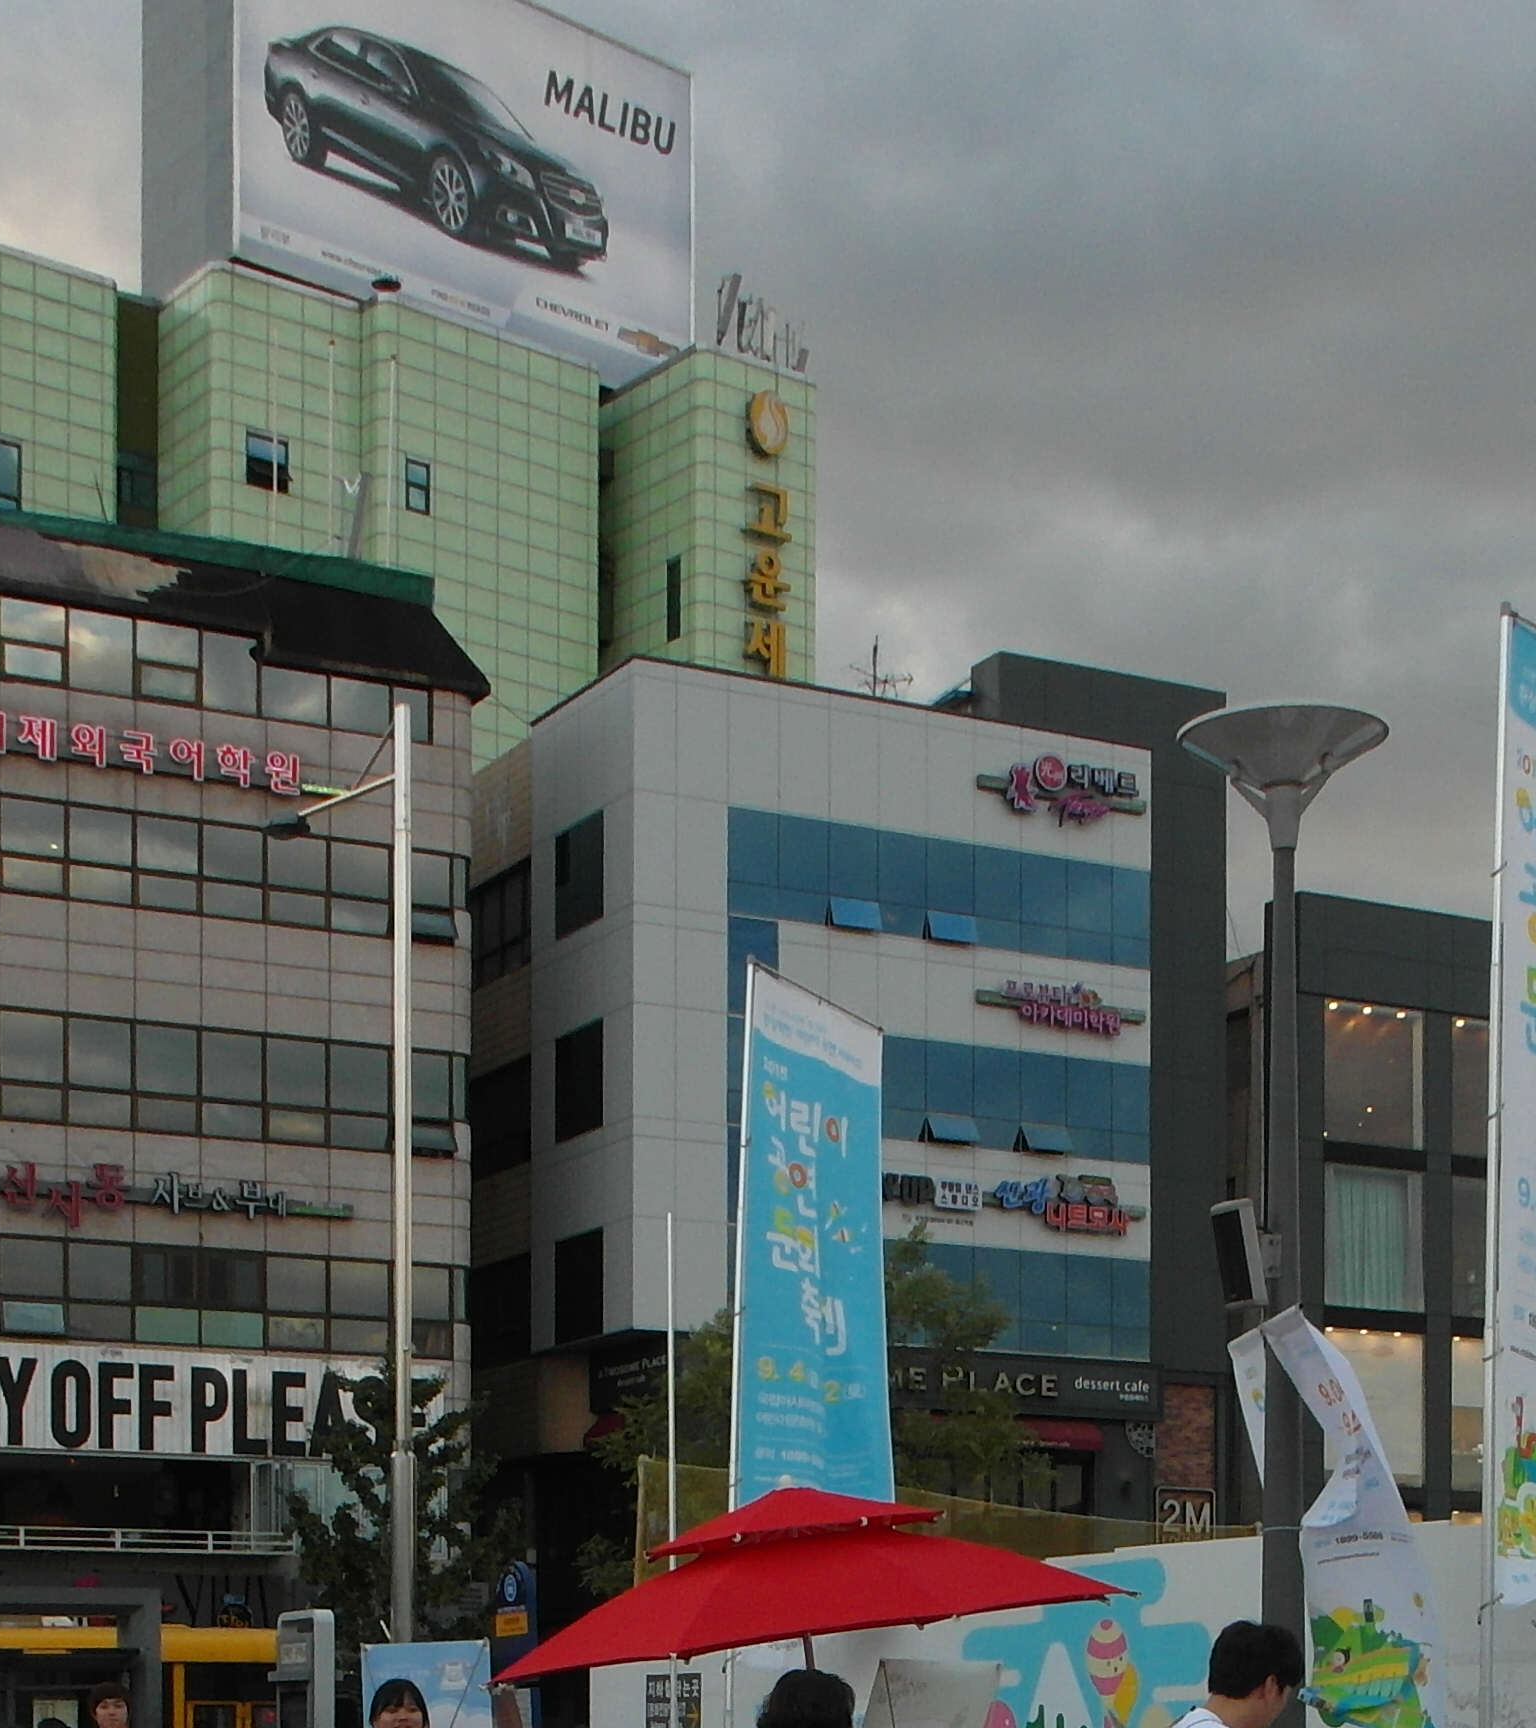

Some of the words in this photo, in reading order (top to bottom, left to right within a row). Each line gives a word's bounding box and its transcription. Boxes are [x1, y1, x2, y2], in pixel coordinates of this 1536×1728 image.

[544, 69, 676, 155] MALIBU
[535, 296, 610, 333] CHEVROLET
[2, 1162, 128, 1229] 신사동
[941, 1365, 1060, 1398] PLACE
[1074, 1375, 1121, 1392] dessert
[1125, 1379, 1150, 1394] cafe
[51, 1359, 175, 1450] OFF
[1160, 1498, 1212, 1534] 2M
